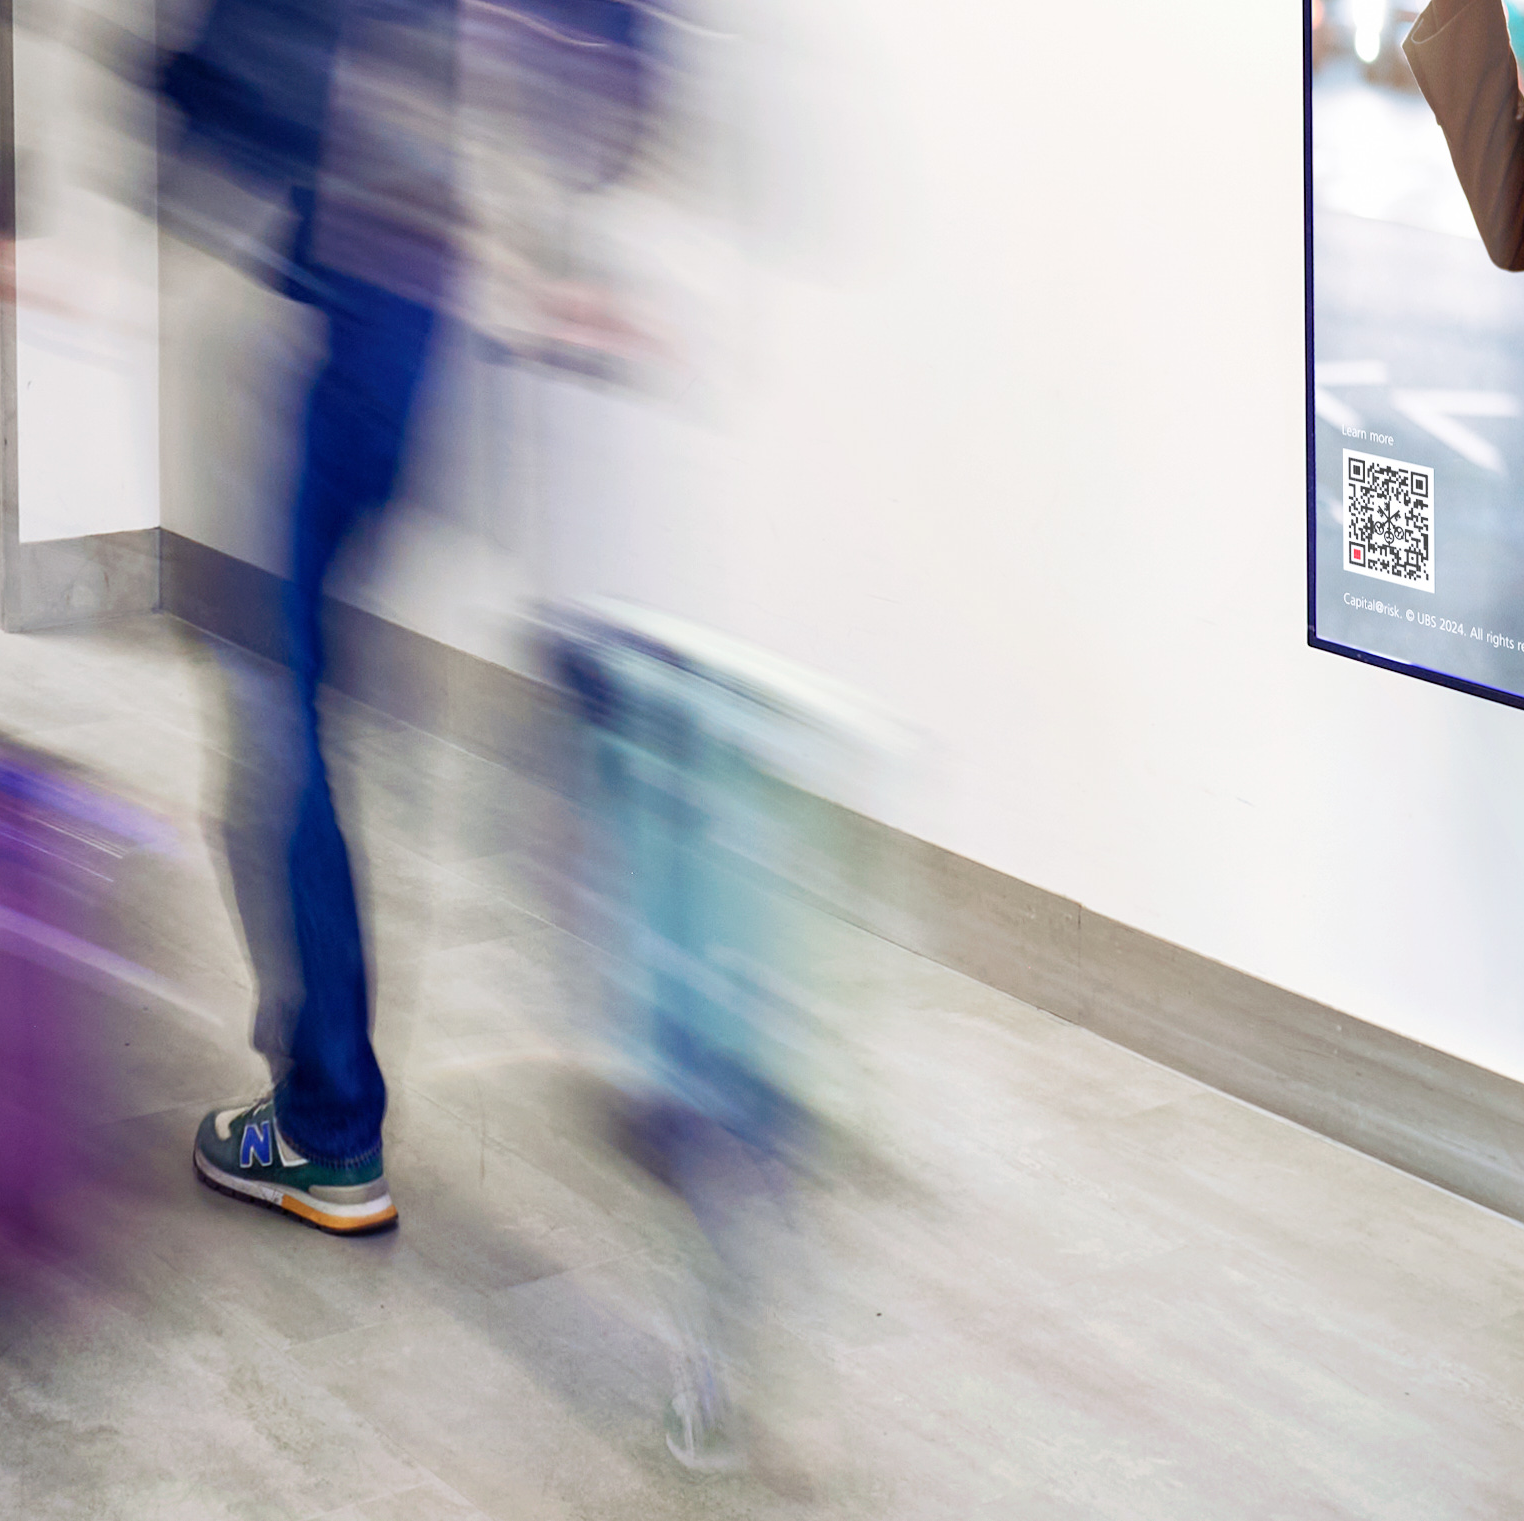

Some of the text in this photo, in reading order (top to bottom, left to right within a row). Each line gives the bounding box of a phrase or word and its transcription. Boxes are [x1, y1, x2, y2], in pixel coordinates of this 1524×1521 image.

[1342, 424, 1395, 446] Learn more
[1343, 592, 1403, 619] Capital@risk.
[1417, 611, 1437, 629] UBS
[1439, 618, 1467, 637] 2024.
[1470, 626, 1483, 641] All
[1486, 628, 1515, 650] rights
[240, 1120, 273, 1168] N
